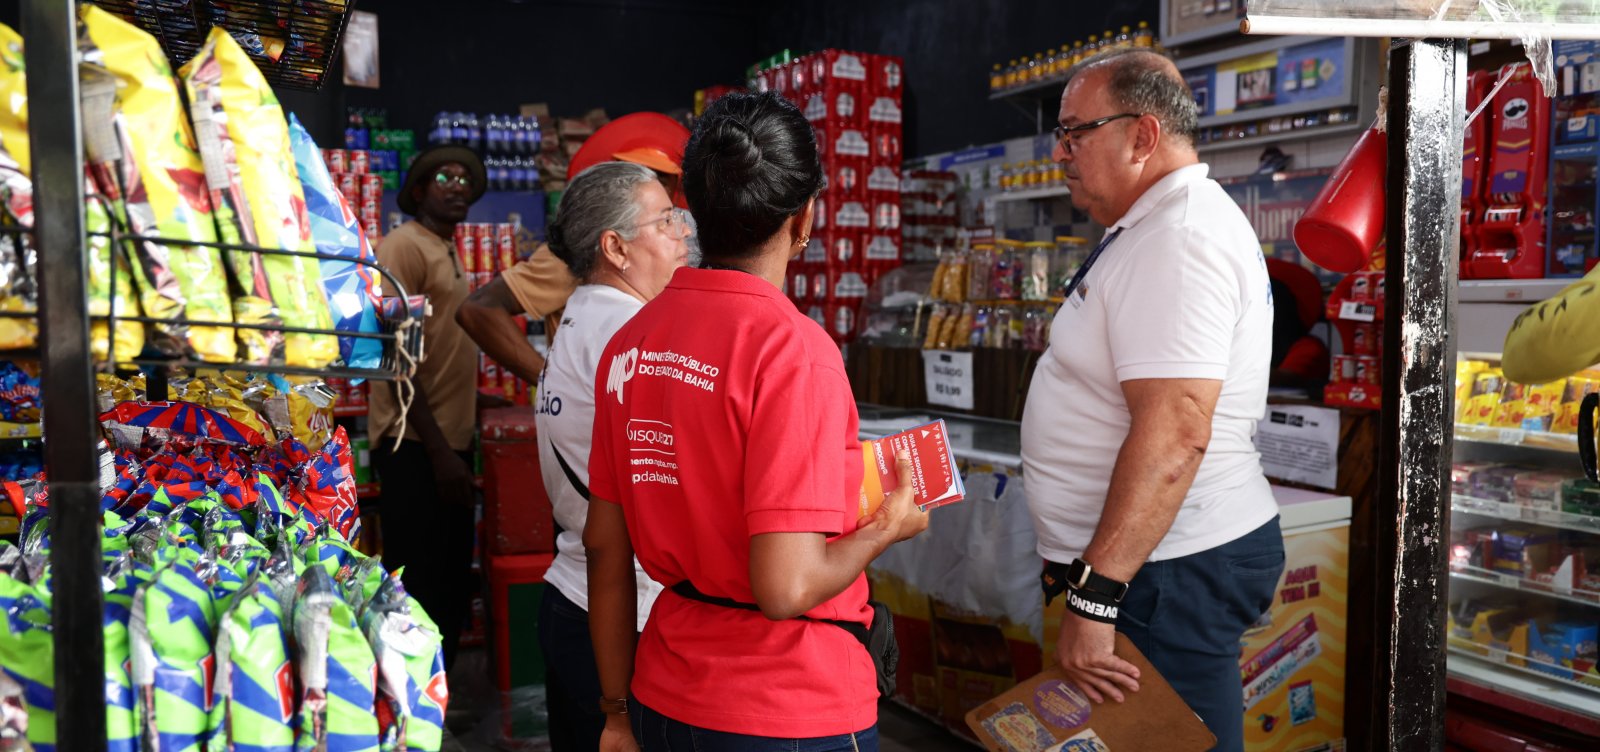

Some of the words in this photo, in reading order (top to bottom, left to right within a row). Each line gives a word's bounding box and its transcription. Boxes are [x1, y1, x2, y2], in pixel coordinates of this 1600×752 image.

[641, 349, 678, 363] MINISTÉRIO
[678, 355, 719, 378] PÚBLICO
[638, 364, 655, 375] DO
[655, 366, 672, 377] ESTADO
[671, 370, 683, 381] DA
[684, 373, 715, 392] BAHIA
[874, 442, 886, 469] PROCON
[911, 448, 918, 456] DE
[631, 470, 679, 485] pdabahia
[913, 456, 926, 489] SEGURANÇA
[912, 486, 919, 495] DE
[921, 489, 928, 498] NA
[1070, 594, 1119, 619] OVERNO
